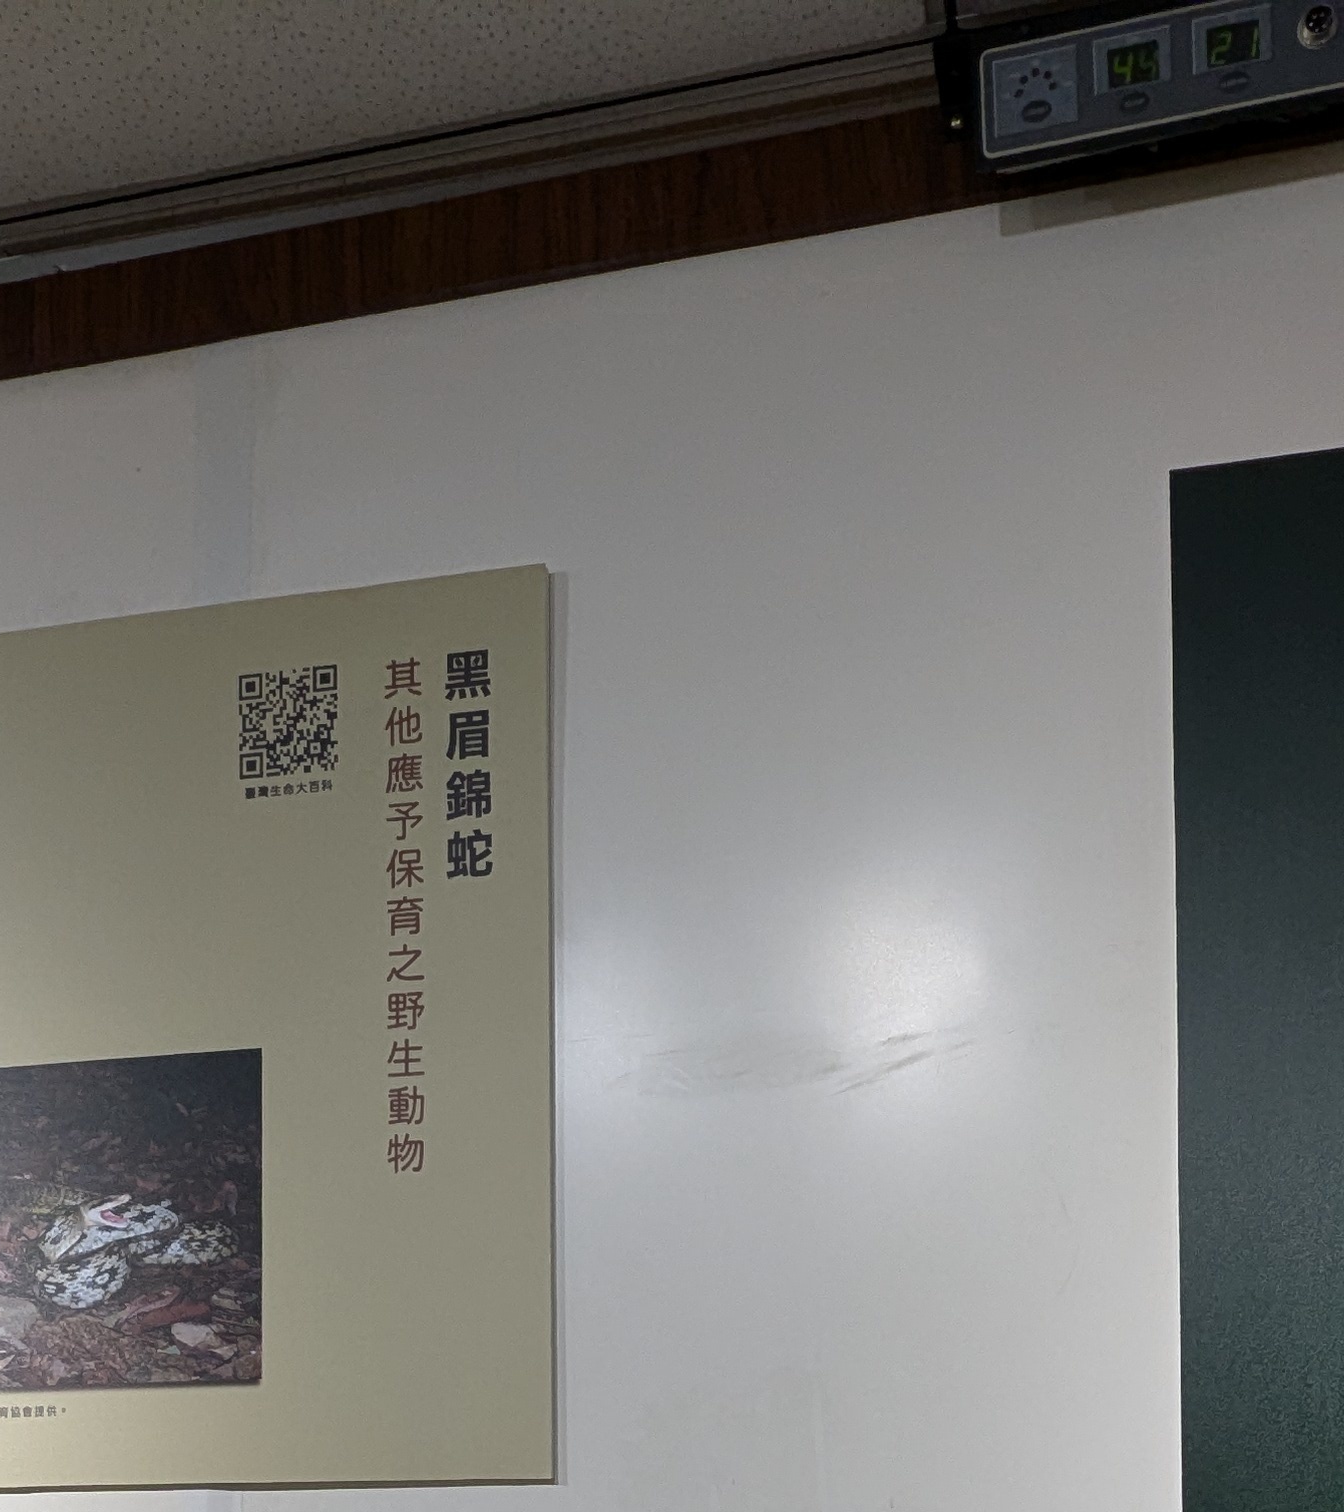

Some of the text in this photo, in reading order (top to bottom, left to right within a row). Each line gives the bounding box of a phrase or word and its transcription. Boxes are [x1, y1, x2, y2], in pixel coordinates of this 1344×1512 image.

[1211, 27, 1259, 66] 21
[244, 780, 334, 801] 臺灣生命大百科
[444, 648, 494, 880] 黑眉錦蛇
[383, 657, 426, 1174] 其他應予保育之野生動物
